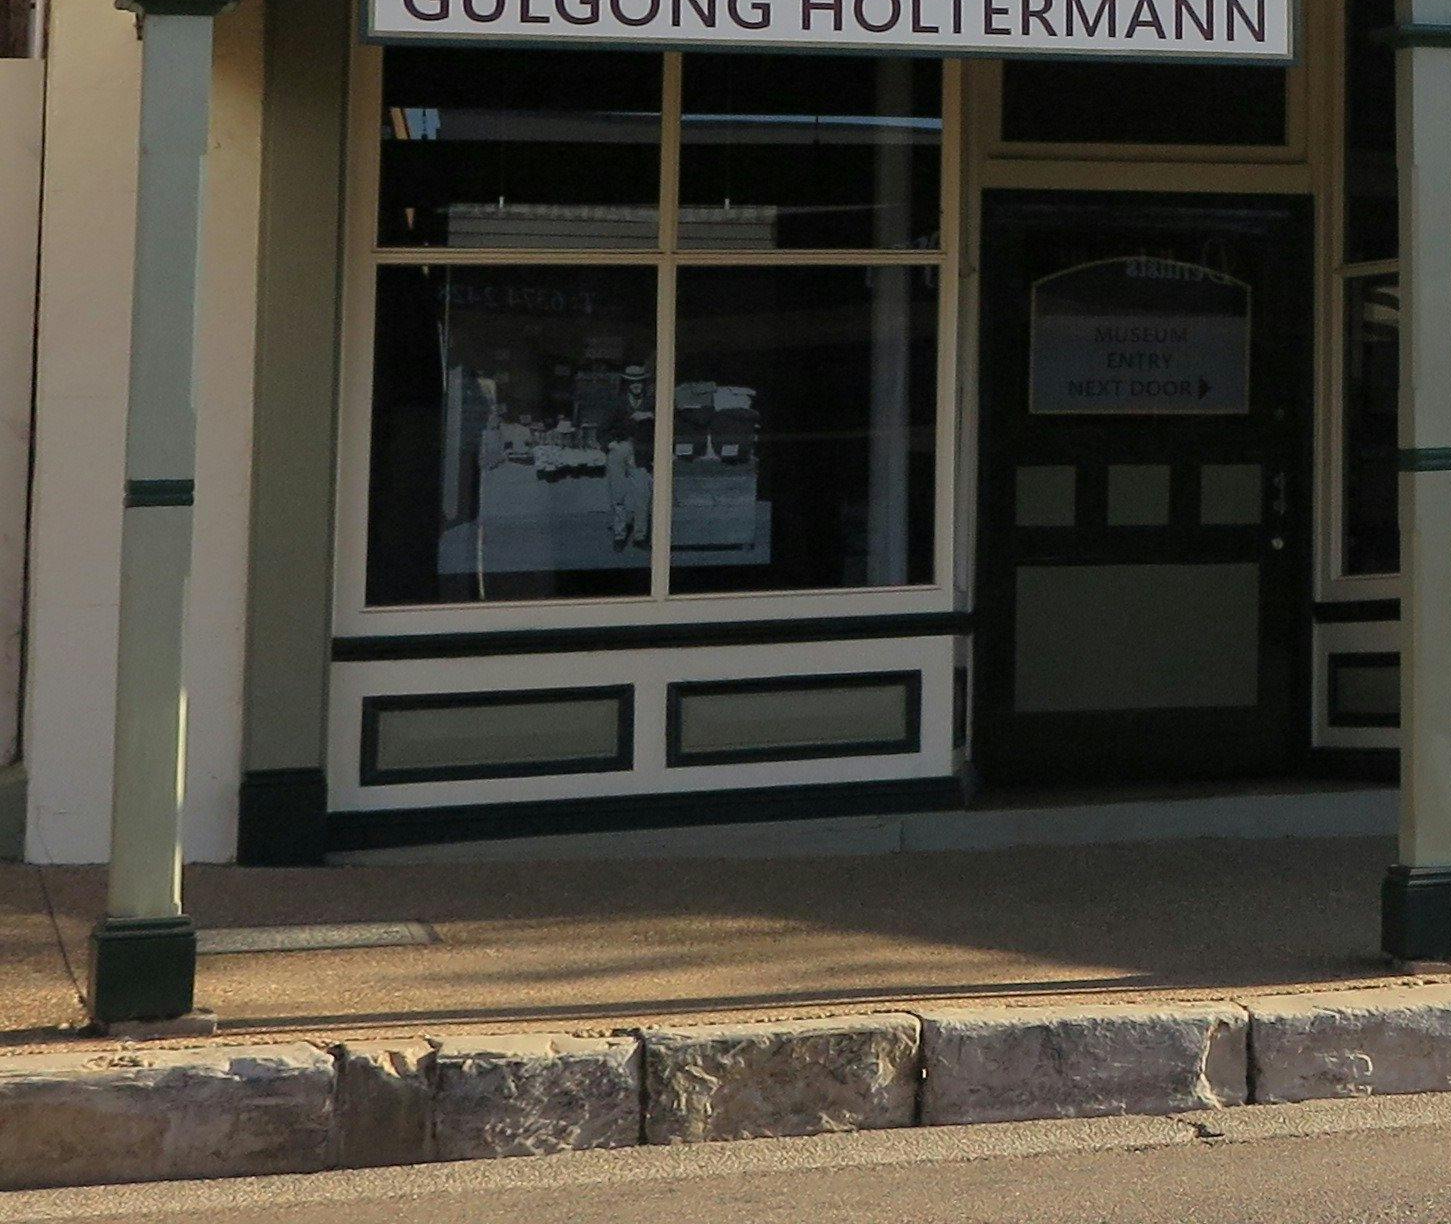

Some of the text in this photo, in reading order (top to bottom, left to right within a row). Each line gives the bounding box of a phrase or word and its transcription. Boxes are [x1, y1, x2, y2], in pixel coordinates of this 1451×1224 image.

[1094, 327, 1188, 343] MUSEUM
[1106, 352, 1173, 369] ENTRY
[1067, 380, 1192, 396] NEXT DOOR
